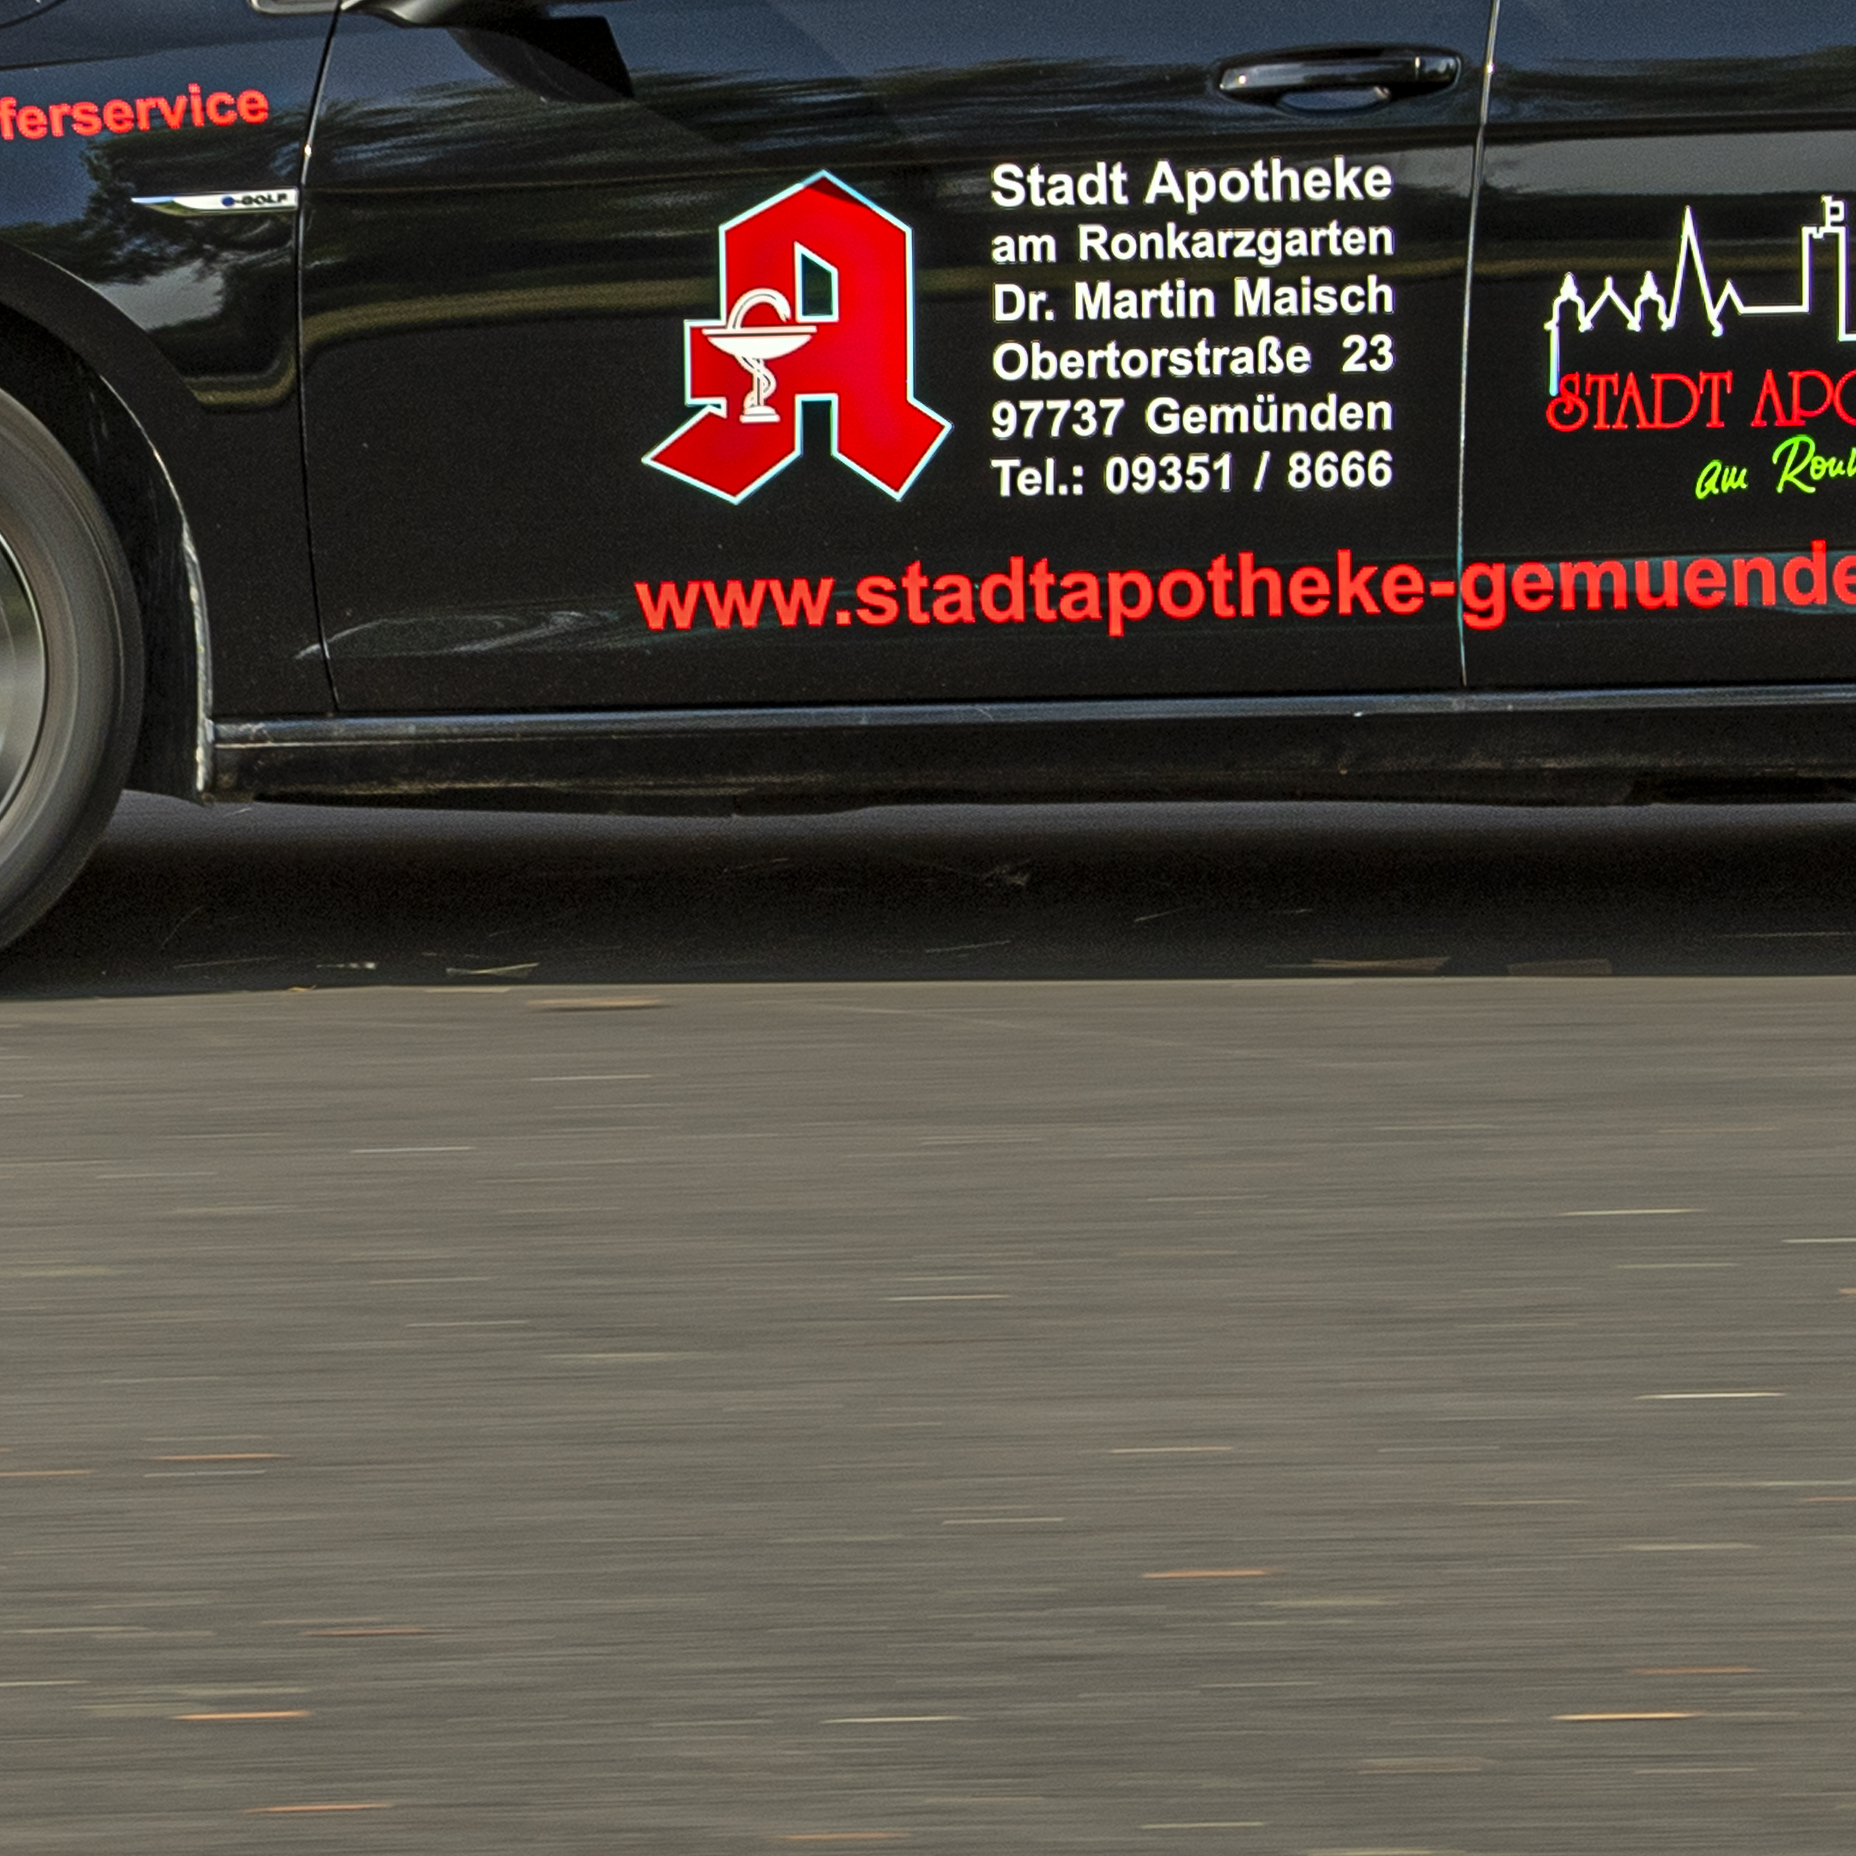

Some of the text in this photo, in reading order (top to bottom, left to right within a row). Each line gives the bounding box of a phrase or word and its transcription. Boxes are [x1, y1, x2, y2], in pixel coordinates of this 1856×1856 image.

[991, 156, 1393, 215] Stadt Apotheke
[991, 219, 1395, 267] am Ronkarzgarten
[993, 274, 1395, 323] Dr. Martin Maisch
[992, 332, 1395, 382] Obertorstraße 23
[991, 392, 1394, 440] 97737 Gemünden
[1544, 367, 1734, 434] STADT
[989, 449, 1394, 498] Tel.: 09351 / 8666
[1694, 458, 1750, 501] am
